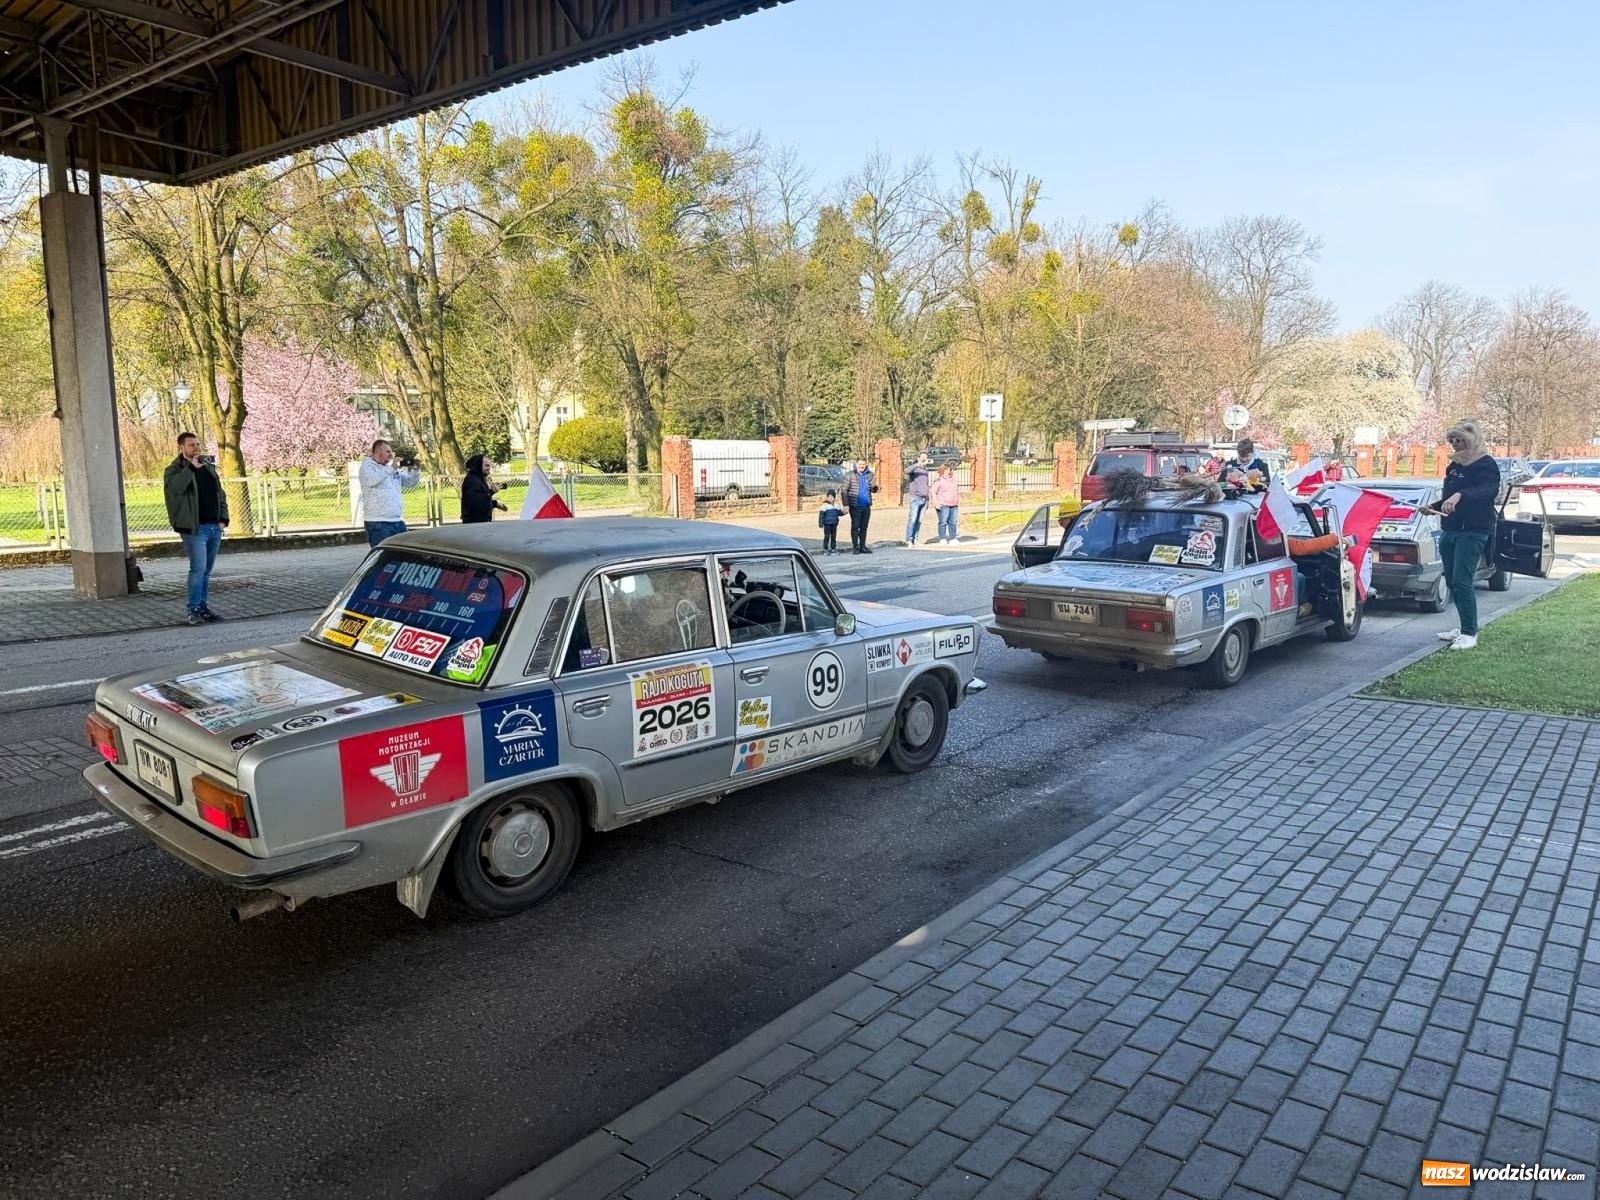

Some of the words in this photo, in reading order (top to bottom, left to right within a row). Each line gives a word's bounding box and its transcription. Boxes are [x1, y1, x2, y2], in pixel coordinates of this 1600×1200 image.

[392, 562, 442, 589] POLSKI
[389, 593, 404, 604] 100
[433, 601, 449, 613] 140
[458, 606, 475, 617] 160
[1074, 605, 1095, 615] 7341
[410, 637, 442, 655] FSO
[939, 634, 970, 650] FILIPPO
[388, 651, 408, 662] AUTO
[409, 656, 431, 668] KLUB
[867, 643, 891, 660] ŚLIWKA
[641, 677, 666, 700] RAJD
[667, 669, 705, 692] KOGUTA
[812, 663, 839, 696] 99
[640, 697, 710, 735] 2026
[389, 731, 419, 744] MUZEUM
[379, 738, 430, 756] MOTORYZACJI
[503, 740, 540, 755] MARIAN
[499, 749, 544, 767] CZARTER
